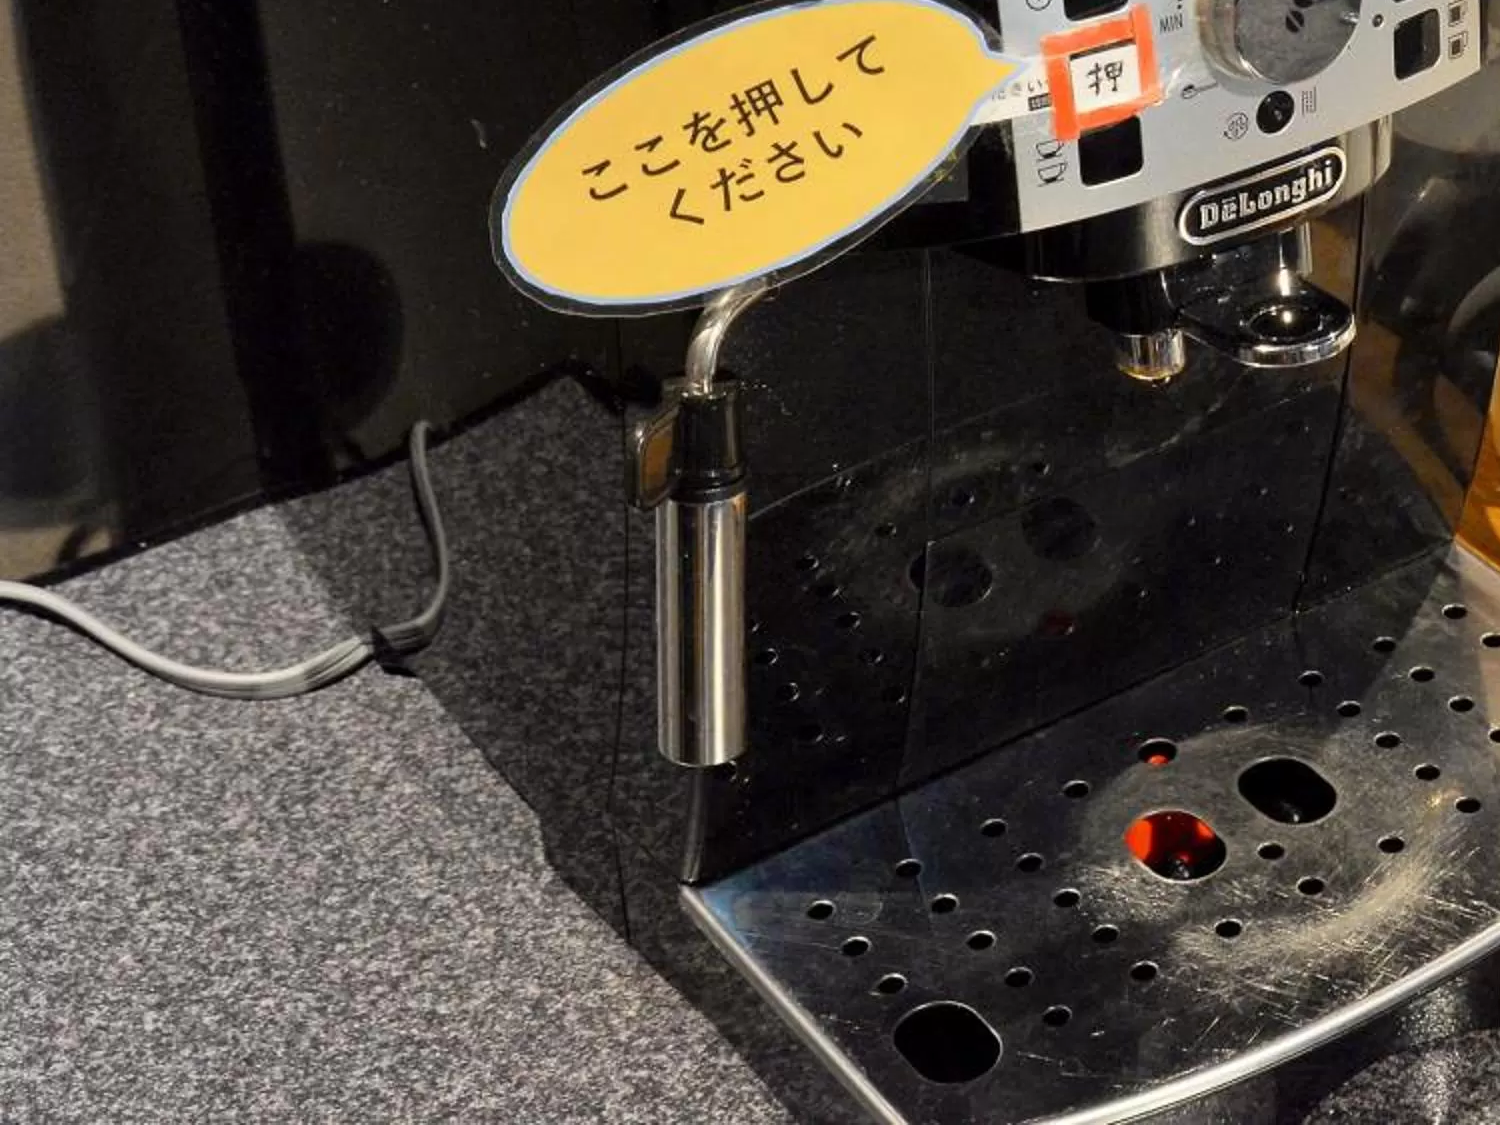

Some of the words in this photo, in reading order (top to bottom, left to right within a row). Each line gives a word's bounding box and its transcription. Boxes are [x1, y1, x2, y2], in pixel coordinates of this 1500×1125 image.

[1159, 13, 1184, 34] MIN
[1086, 61, 1125, 97] 押
[582, 34, 885, 200] ここを押して
[669, 122, 863, 225] ください
